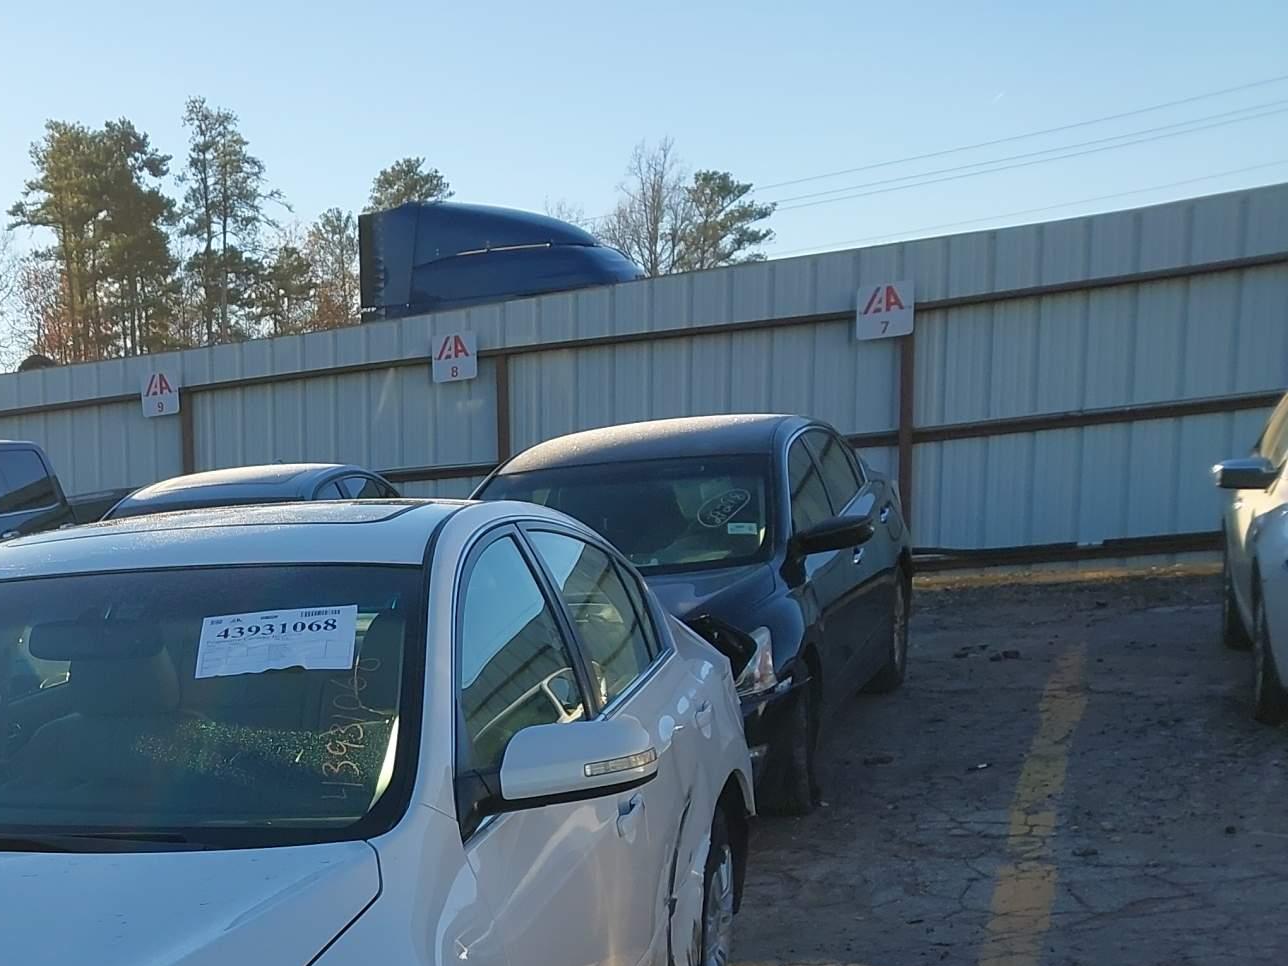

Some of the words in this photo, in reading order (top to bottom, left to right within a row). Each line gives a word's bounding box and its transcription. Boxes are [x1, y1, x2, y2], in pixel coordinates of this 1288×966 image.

[880, 320, 890, 335] 7
[451, 365, 459, 378] 8
[157, 401, 164, 413] 9
[216, 618, 337, 639] 43931068
